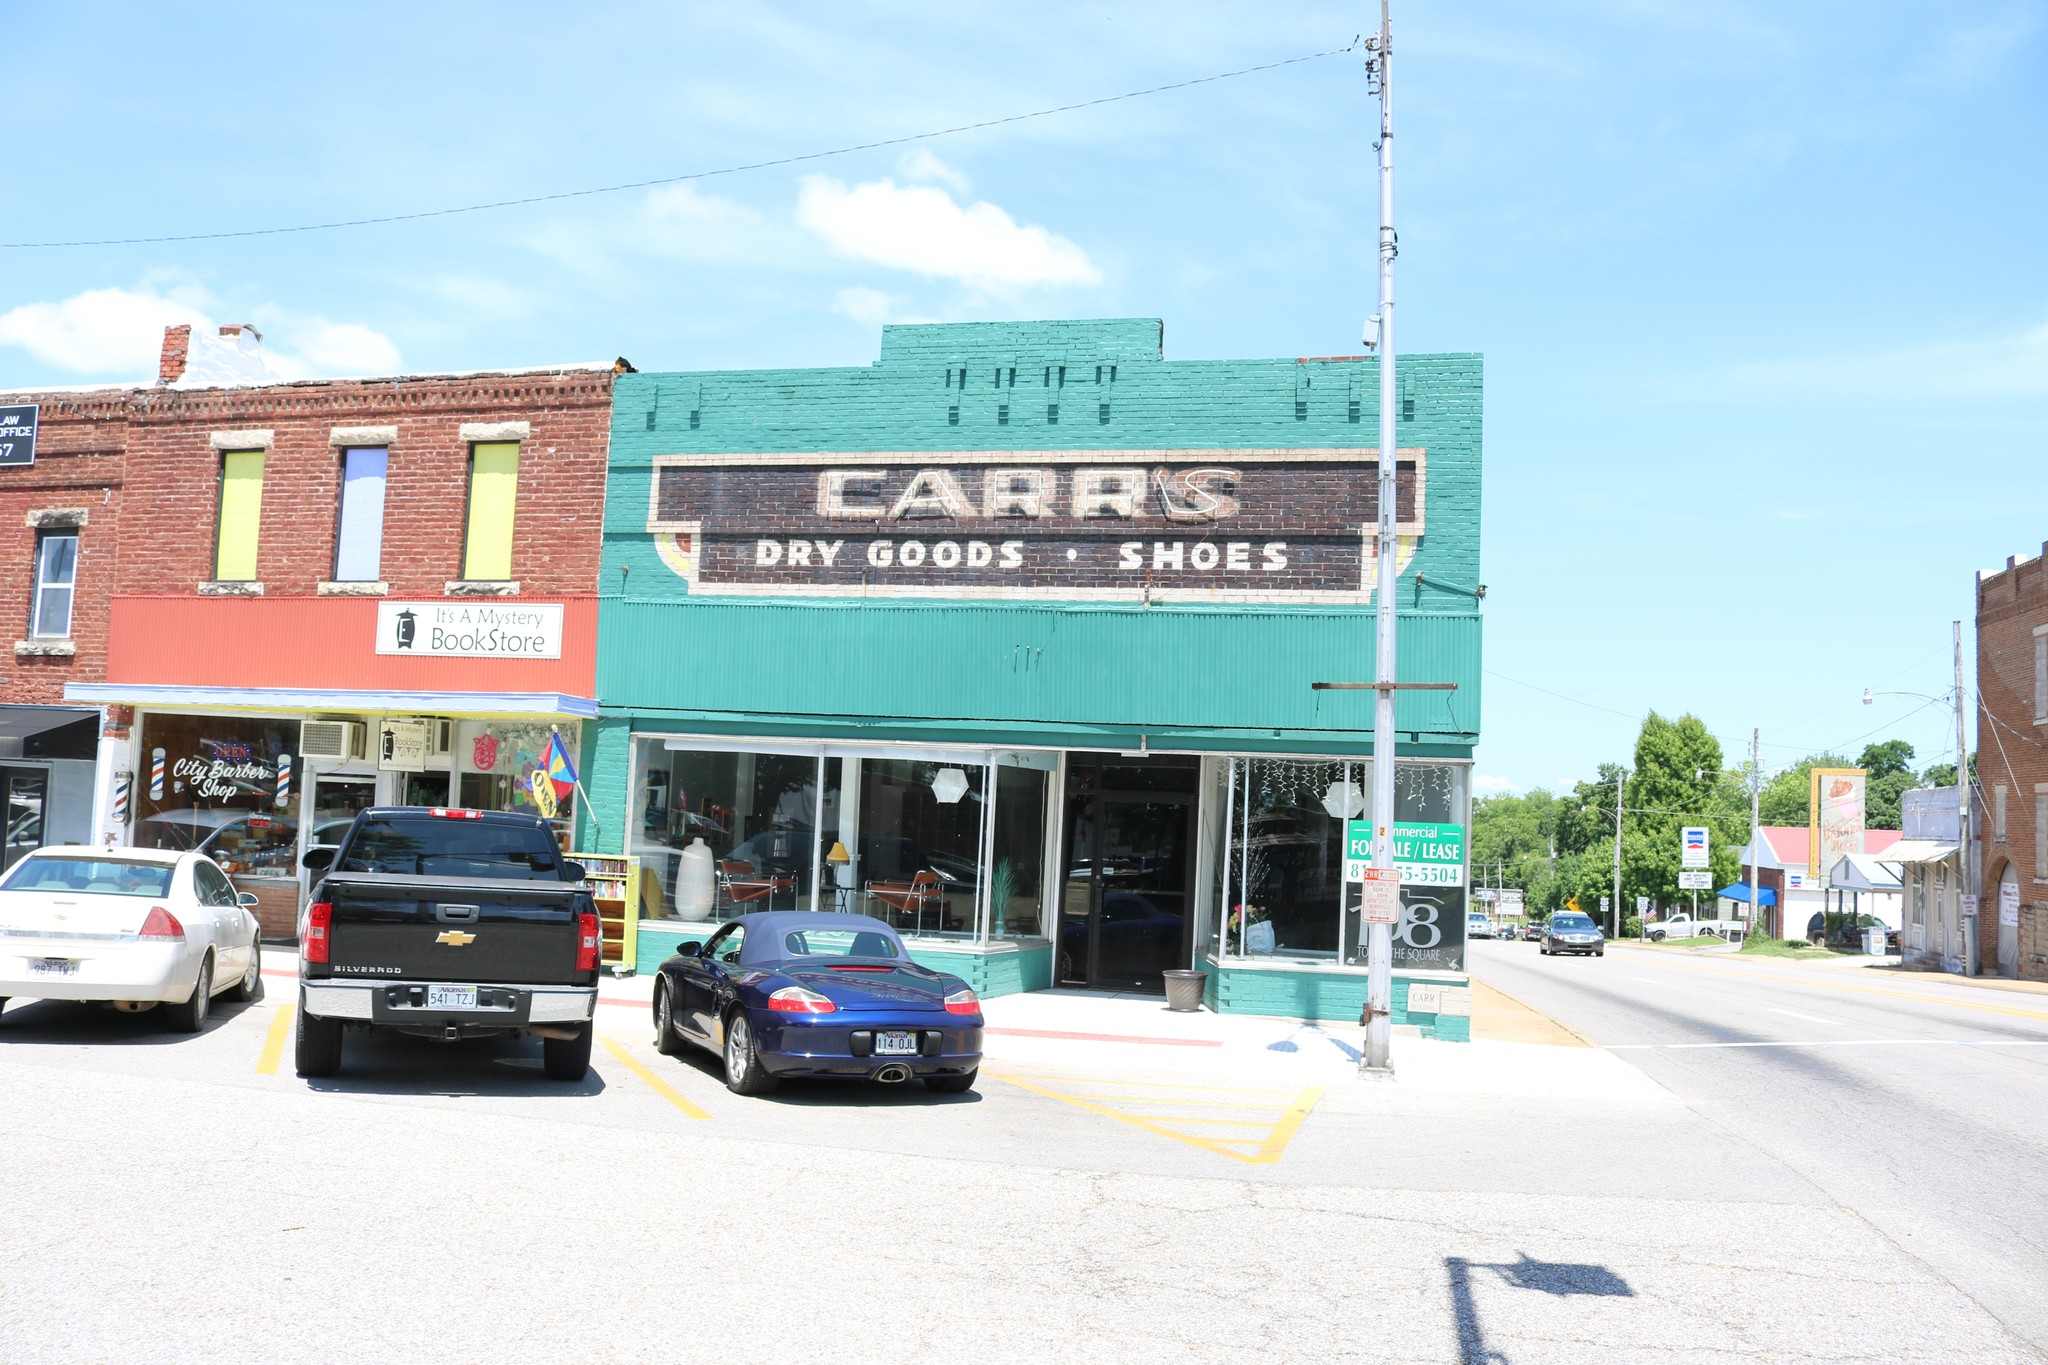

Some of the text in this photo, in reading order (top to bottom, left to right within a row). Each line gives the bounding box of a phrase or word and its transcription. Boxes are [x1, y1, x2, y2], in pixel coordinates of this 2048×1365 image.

[756, 539, 1288, 571] DRY GOODS SHOES
[436, 608, 544, 629] It's A Mystery
[431, 627, 545, 652] BookStore
[215, 746, 247, 757] OPEN
[173, 757, 269, 785] City Barber
[198, 778, 237, 804] Shop
[1393, 826, 1438, 839] mmercial
[1422, 843, 1460, 860] LEASE
[1407, 949, 1441, 962] SQUARE
[34, 965, 75, 976] 987 TWJ
[334, 965, 402, 974] SILVERADO
[430, 993, 475, 1005] 541 TZJ
[1412, 992, 1435, 1003] CARR
[878, 1038, 894, 1050] 114
